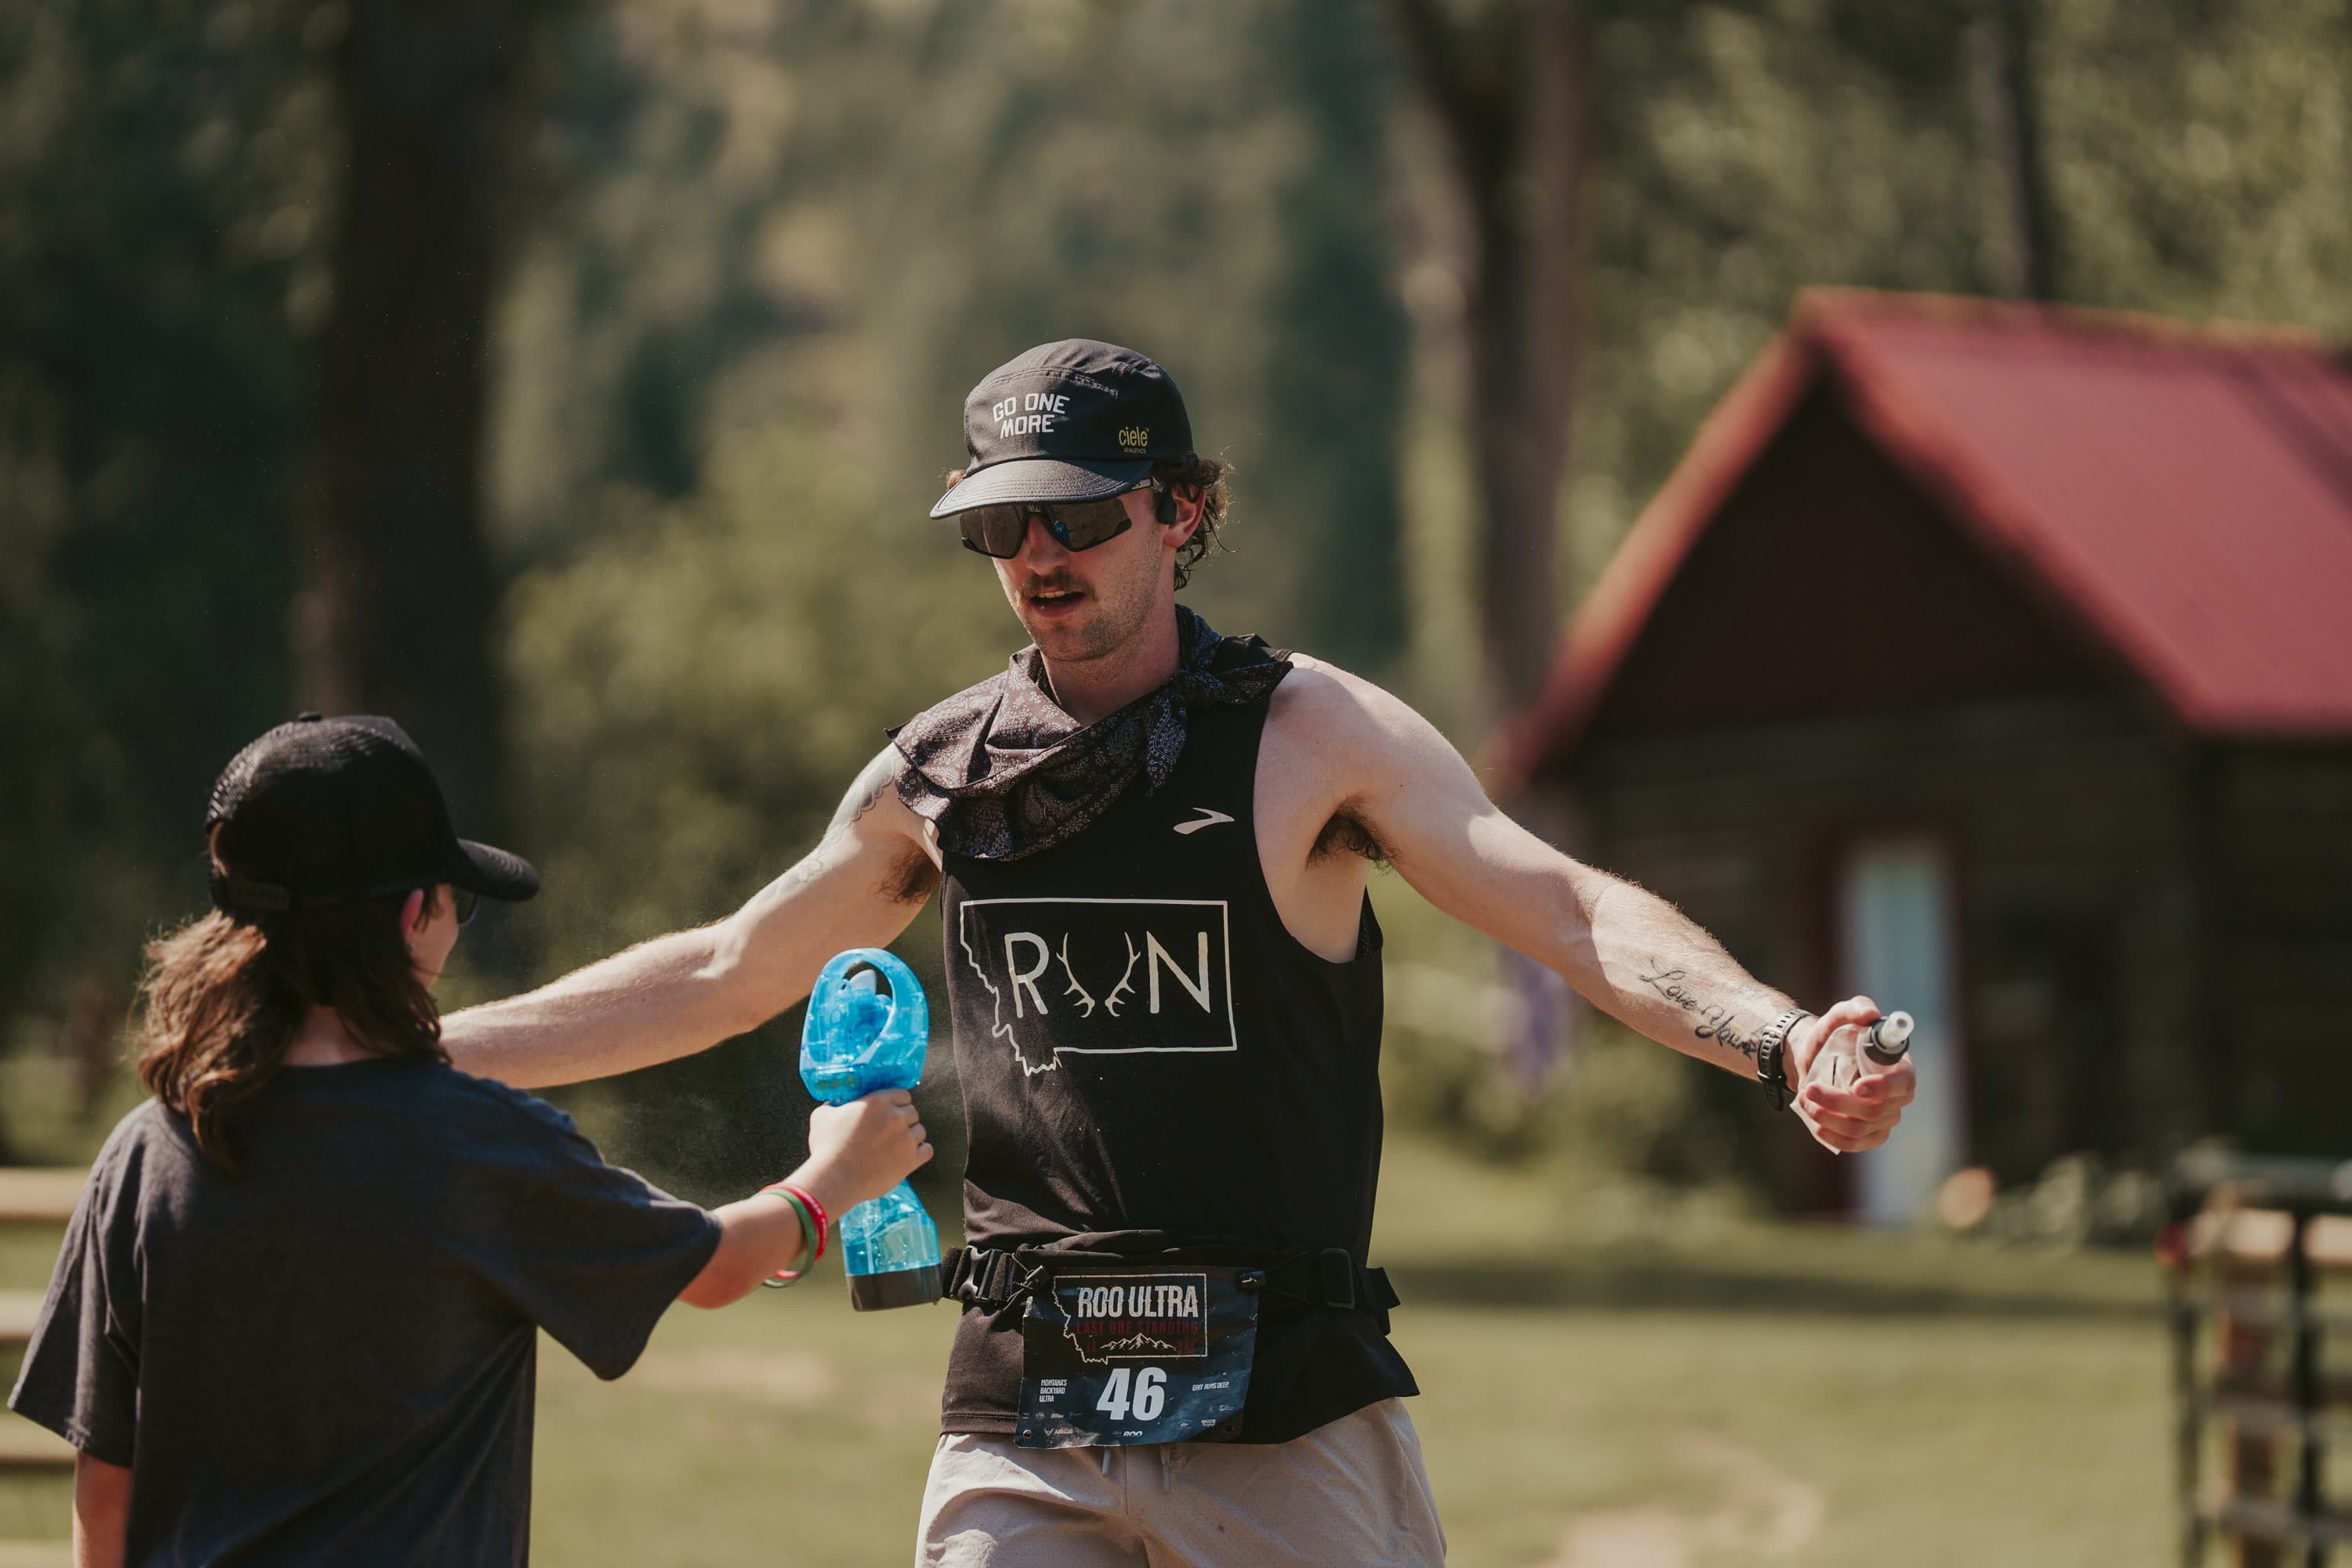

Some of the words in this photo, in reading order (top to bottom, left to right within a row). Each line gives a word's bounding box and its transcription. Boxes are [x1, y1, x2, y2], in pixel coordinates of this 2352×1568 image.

[993, 396, 1017, 423] GO
[1025, 393, 1071, 415] ONE
[1000, 414, 1055, 440] MORE
[1118, 426, 1149, 447] ciele
[1639, 956, 1697, 1011] Love
[1077, 1285, 1124, 1318] ROO
[1128, 1285, 1199, 1318] ULTRA
[1076, 1321, 1104, 1334] LAST
[1109, 1320, 1134, 1334] ONE
[1137, 1320, 1199, 1335] STANDING
[1096, 1367, 1167, 1421] 46
